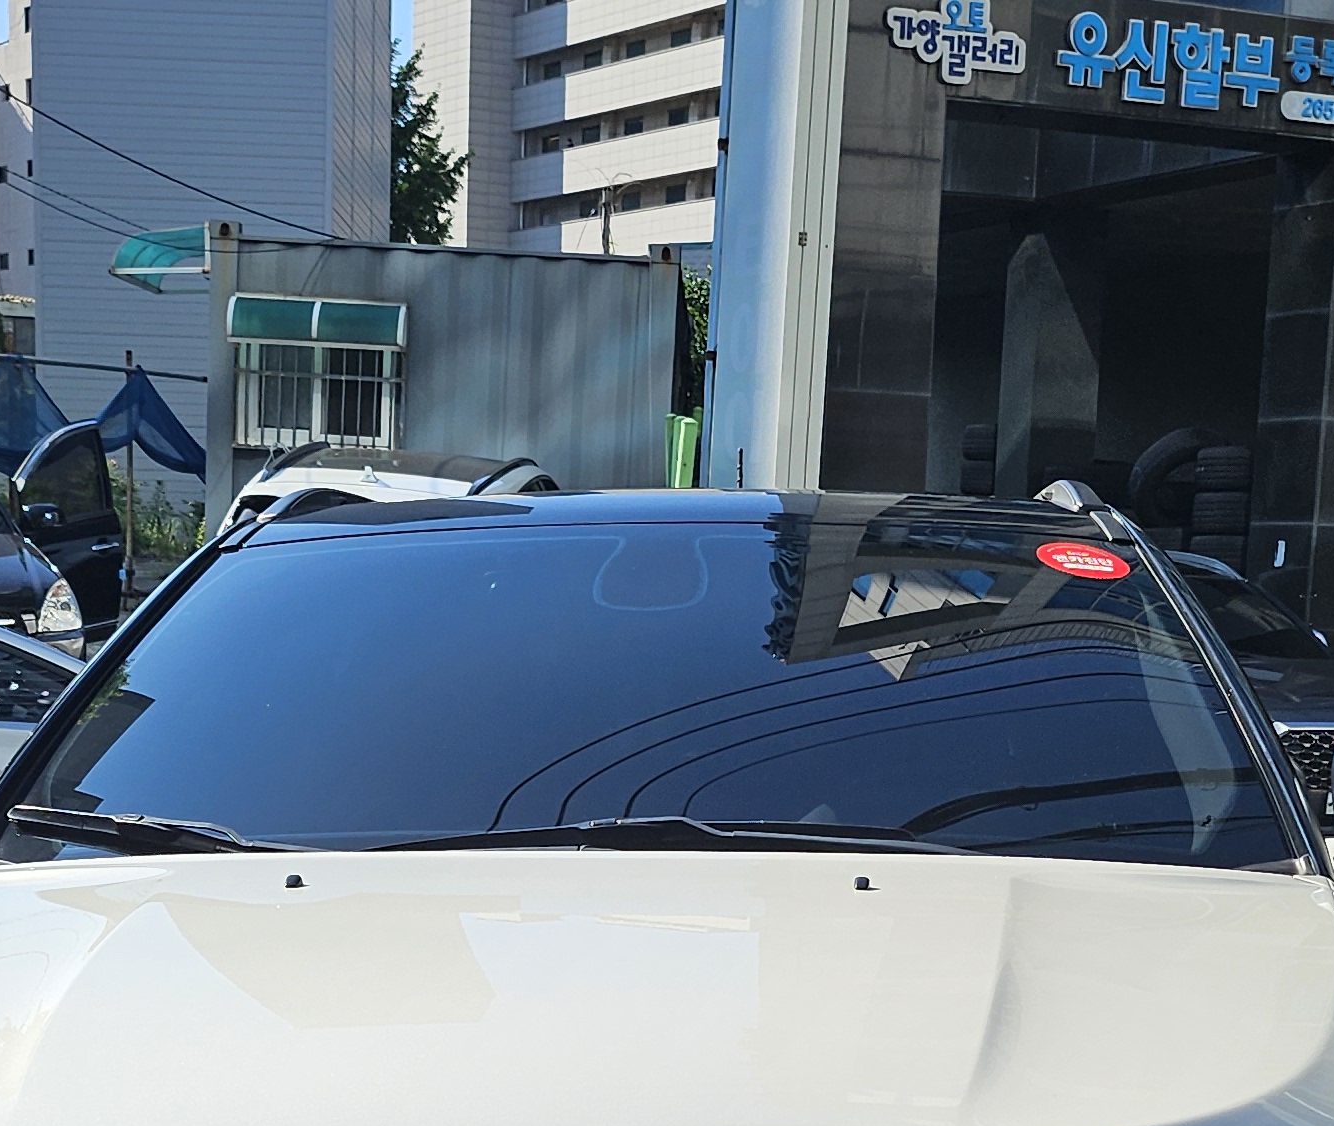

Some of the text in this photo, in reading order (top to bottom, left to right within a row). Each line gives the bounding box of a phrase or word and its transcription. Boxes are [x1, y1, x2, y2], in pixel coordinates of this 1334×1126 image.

[893, 0, 1020, 77] 가양 오토 갤러리
[1057, 11, 1280, 110] 유신할부
